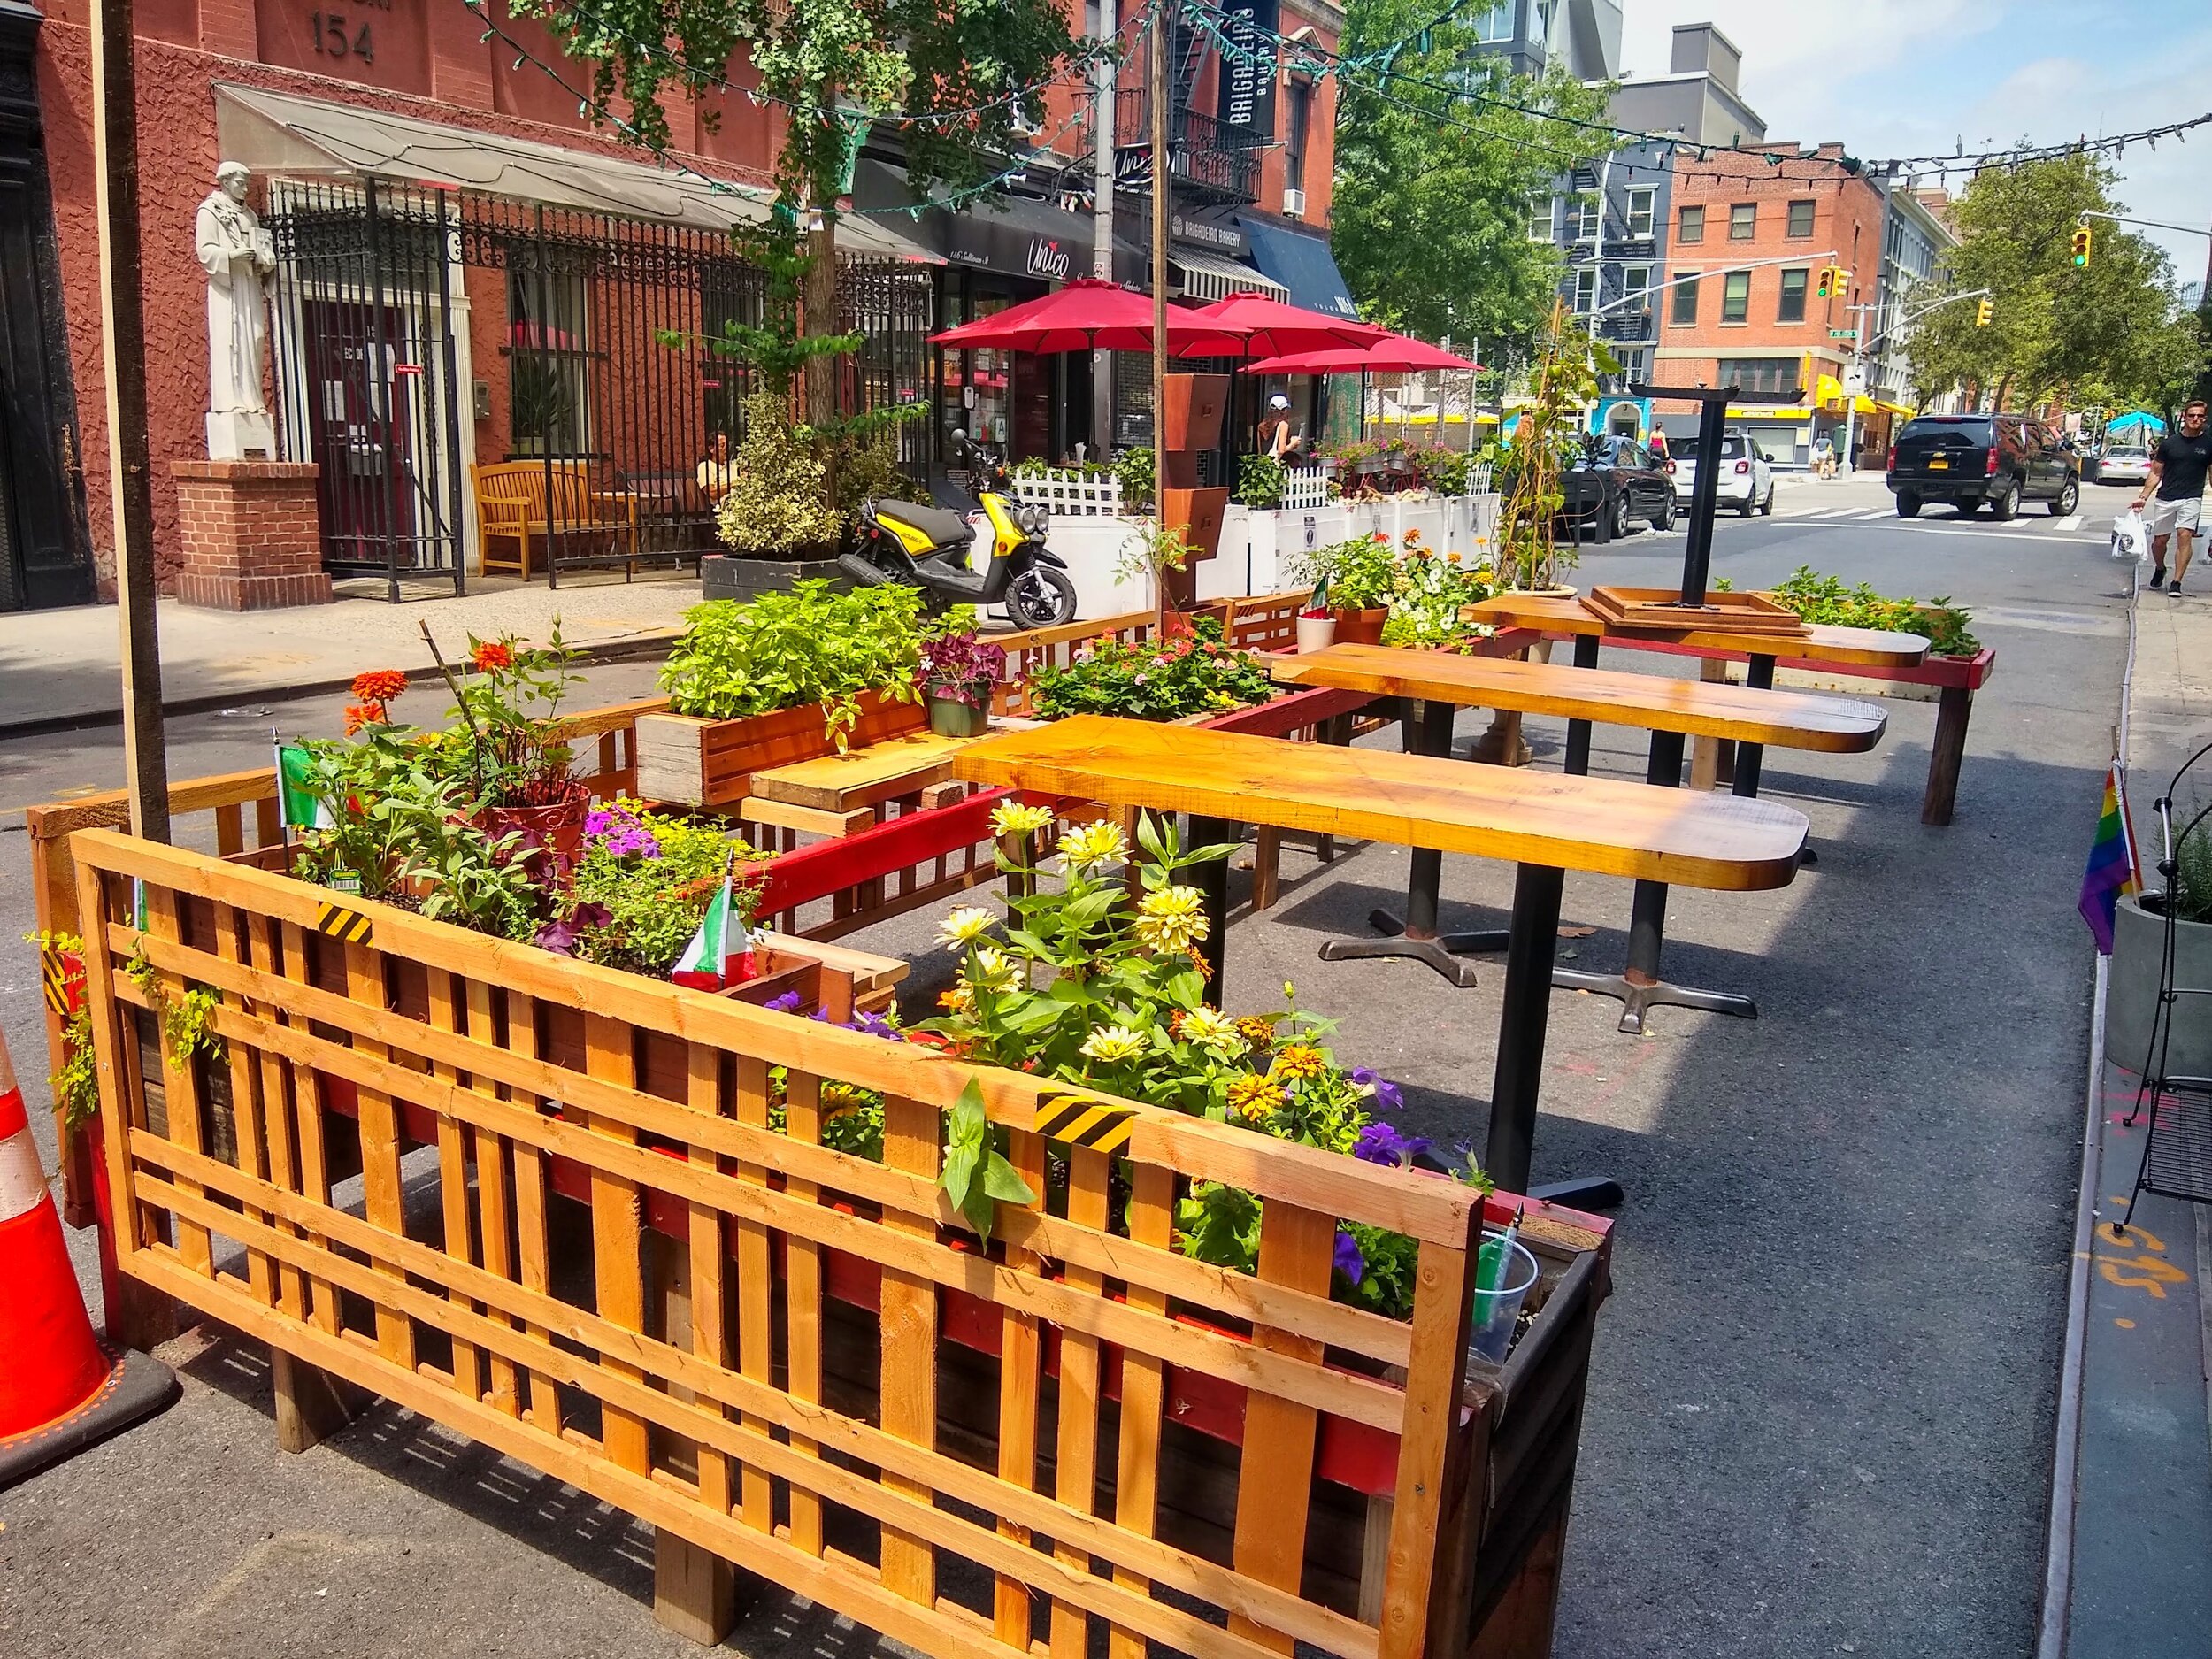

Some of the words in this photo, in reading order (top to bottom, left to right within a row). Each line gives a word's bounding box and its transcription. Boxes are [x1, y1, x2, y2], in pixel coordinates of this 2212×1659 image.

[311, 9, 374, 64] 154
[1185, 220, 1218, 243] BRIGADEIRO
[1218, 229, 1240, 248] BAKERY
[1026, 238, 1070, 277] Unico
[997, 420, 1006, 435] A
